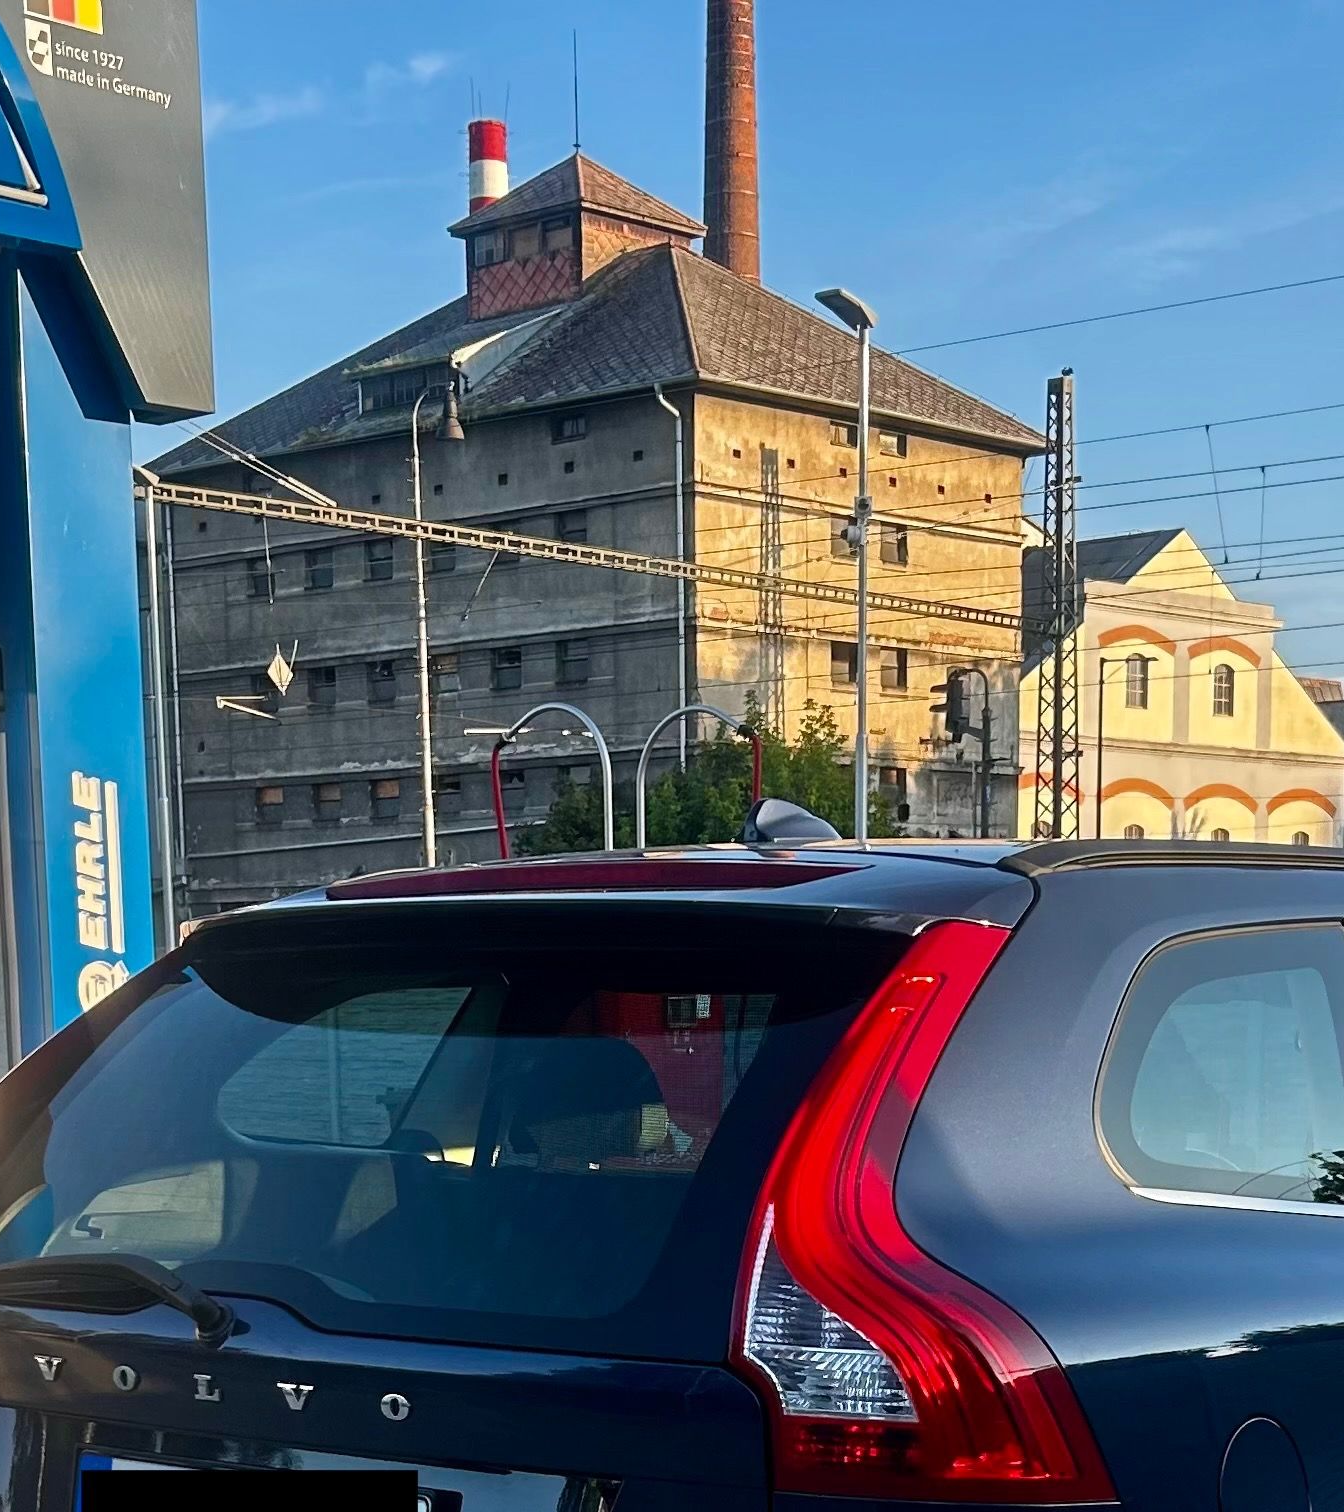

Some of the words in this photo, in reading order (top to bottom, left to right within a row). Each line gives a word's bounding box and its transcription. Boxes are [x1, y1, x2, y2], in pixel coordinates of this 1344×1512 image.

[55, 40, 89, 62] since
[92, 49, 124, 71] 1927
[56, 66, 94, 87] made
[97, 72, 110, 91] in
[113, 77, 171, 109] Germany
[72, 770, 109, 950] EHRLE
[33, 1354, 412, 1422] VOLVO
